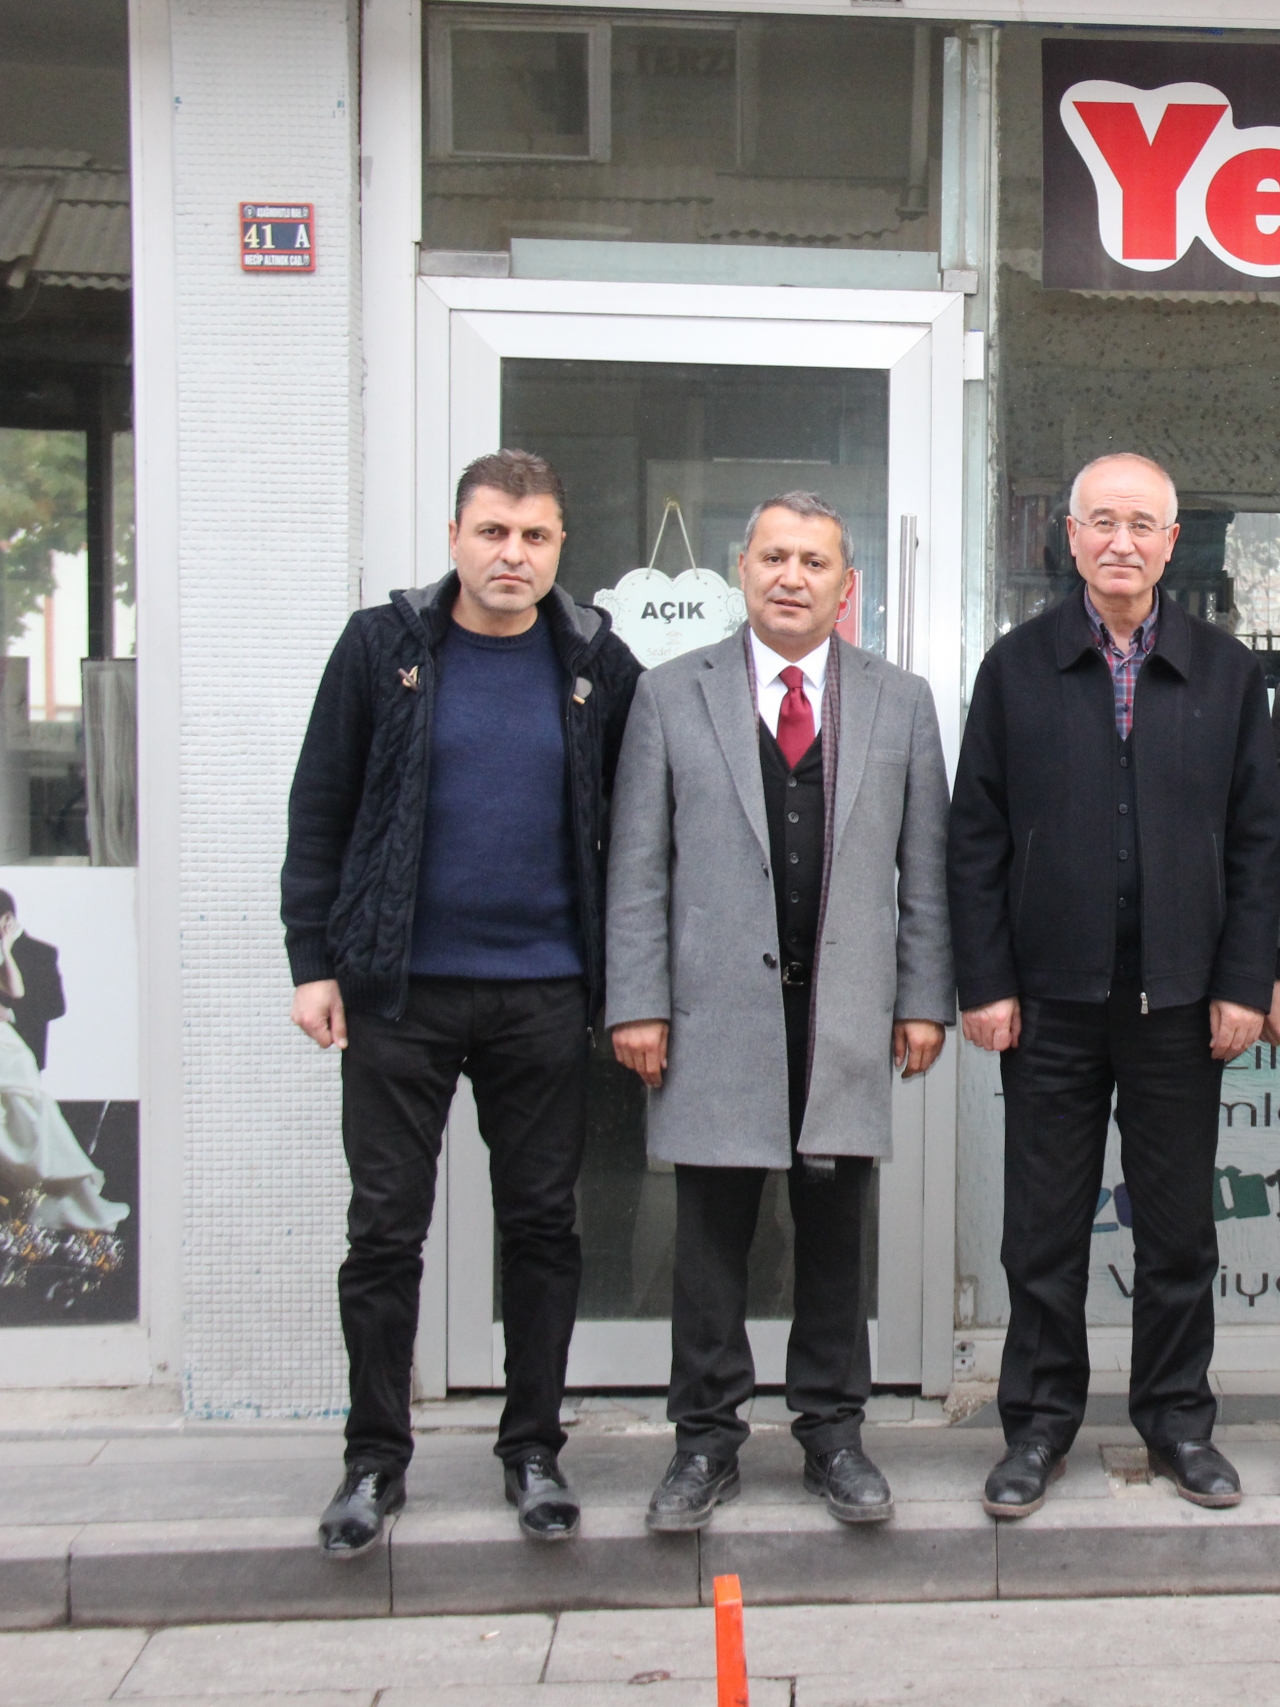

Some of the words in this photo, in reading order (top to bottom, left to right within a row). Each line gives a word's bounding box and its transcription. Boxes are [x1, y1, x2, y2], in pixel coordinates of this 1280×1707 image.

[244, 223, 276, 249] 41
[294, 223, 311, 248] A
[640, 601, 706, 624] AÇIK
